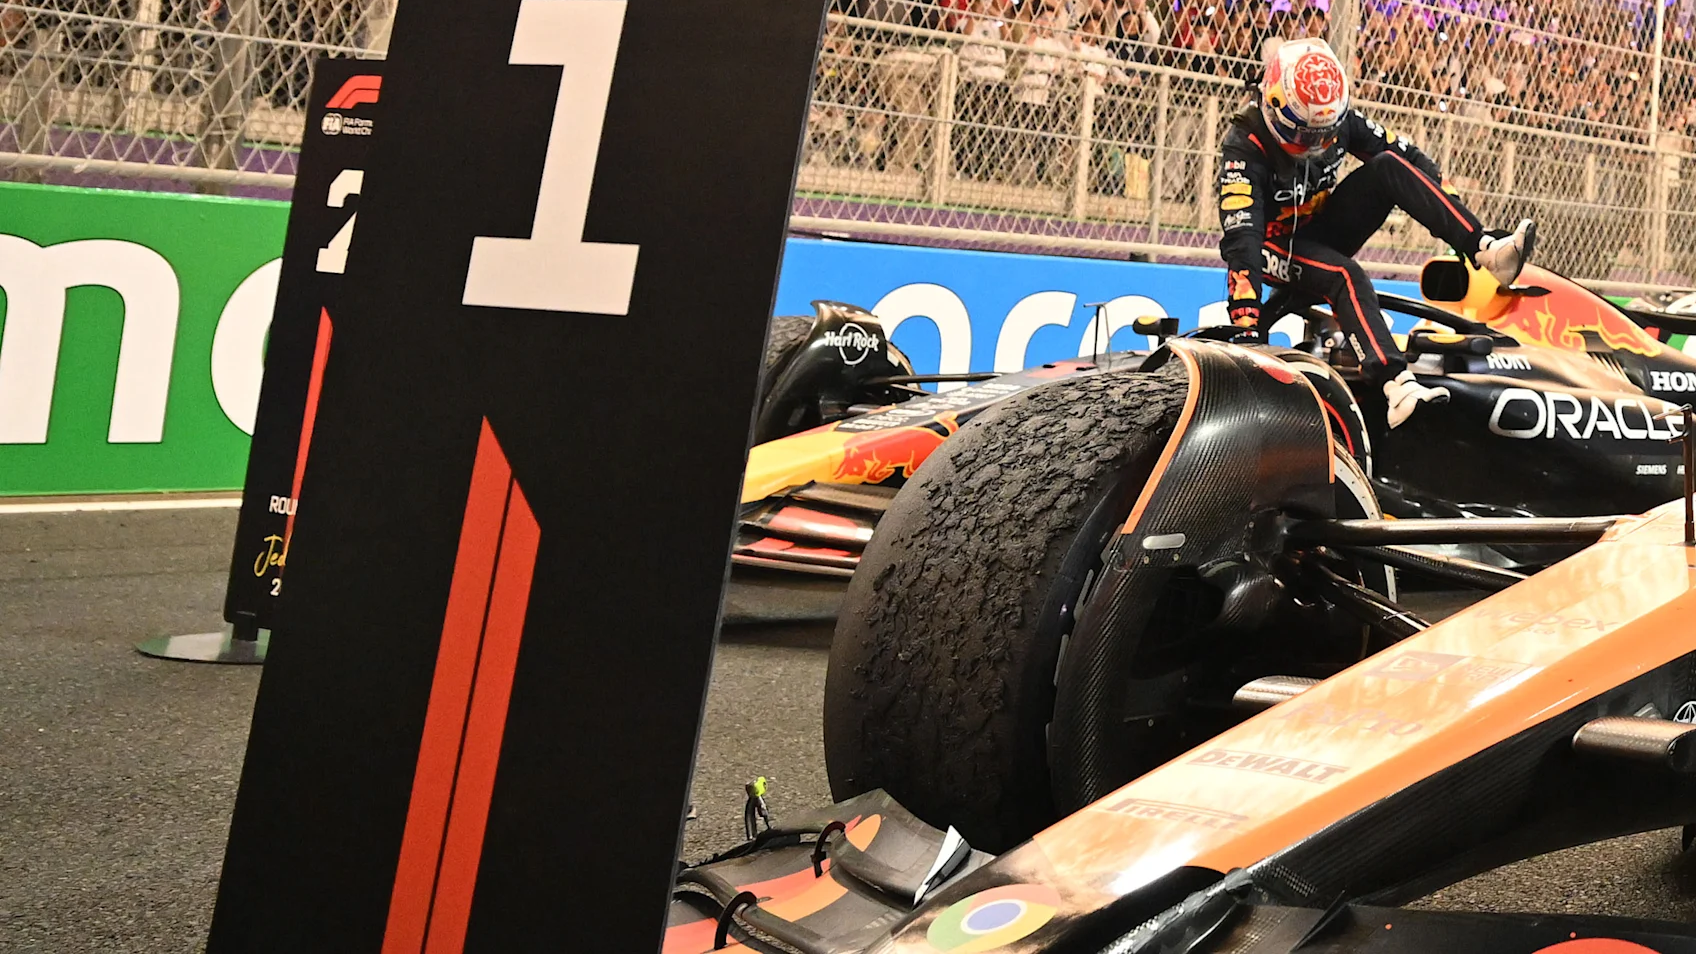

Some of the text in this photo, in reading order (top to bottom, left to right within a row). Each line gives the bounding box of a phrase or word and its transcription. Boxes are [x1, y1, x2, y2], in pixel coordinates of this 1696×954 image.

[853, 332, 879, 352] Rock
[1488, 387, 1686, 440] ORACLE
[1635, 464, 1667, 476] SIEMENS
